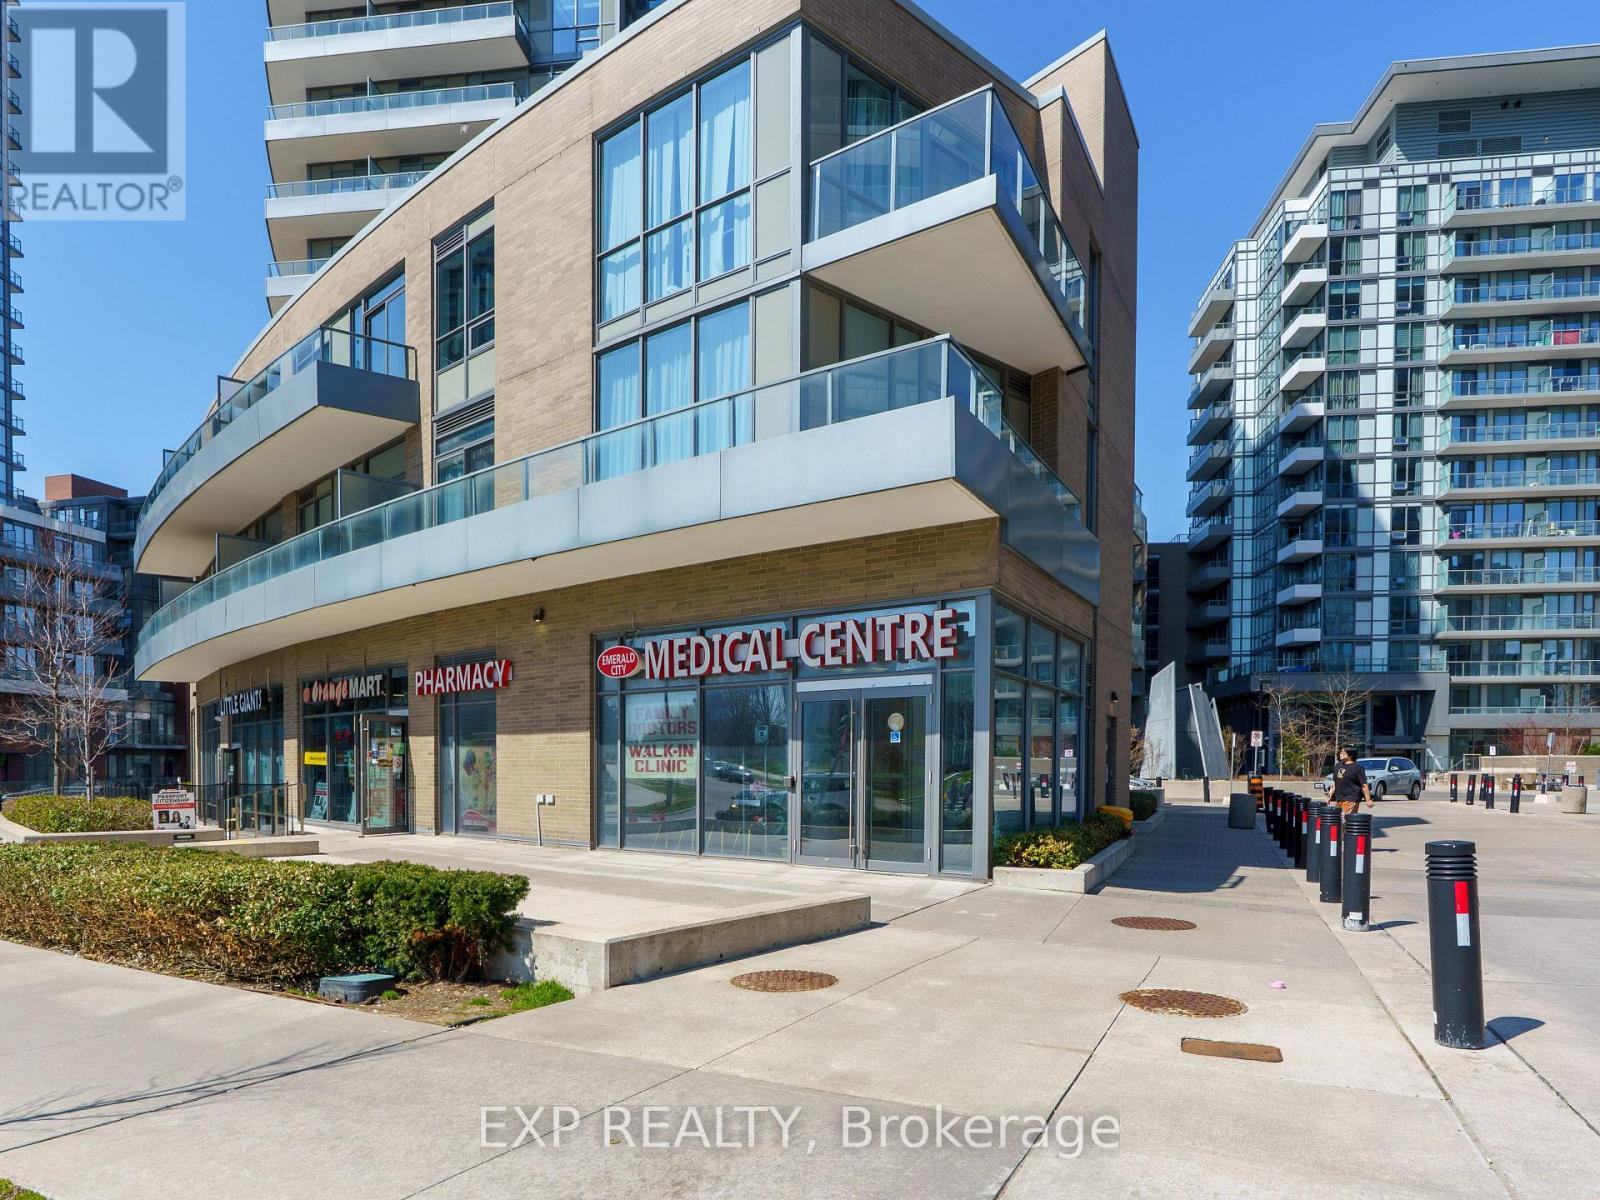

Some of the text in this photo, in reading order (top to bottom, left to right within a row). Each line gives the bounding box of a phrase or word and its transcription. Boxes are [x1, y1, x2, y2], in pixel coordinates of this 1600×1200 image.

[644, 608, 958, 680] MEDICAL CENTRE
[602, 652, 636, 665] EMERALD
[610, 664, 627, 676] CITY
[415, 659, 511, 696] PHARMACY
[220, 688, 262, 716] LITTLE GIANTS
[629, 743, 694, 757] WALK-IN
[634, 759, 687, 773] CLINIC
